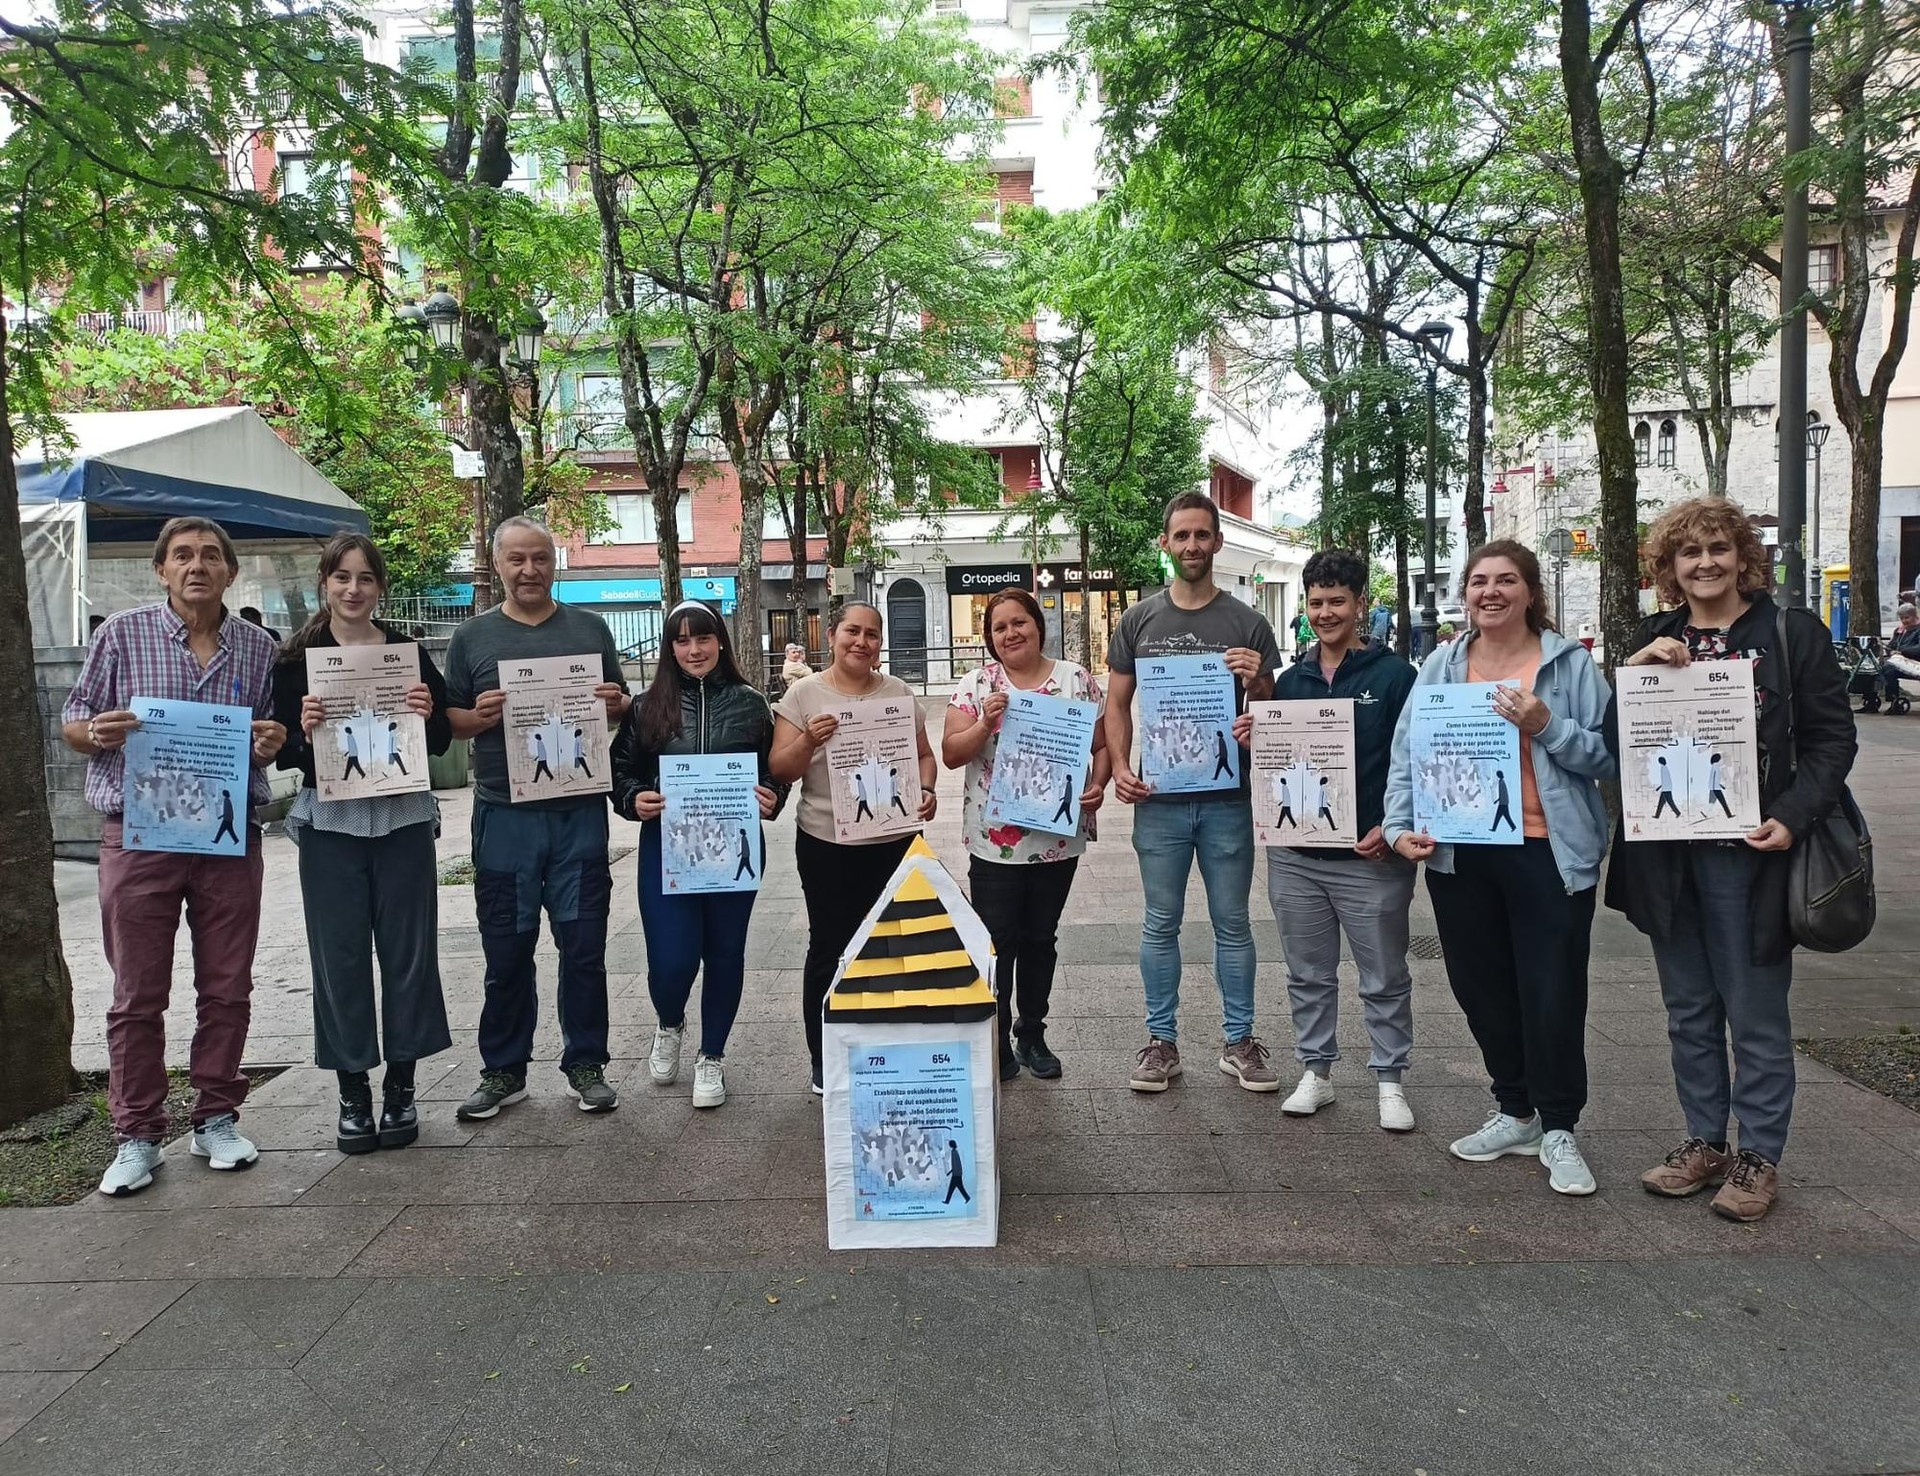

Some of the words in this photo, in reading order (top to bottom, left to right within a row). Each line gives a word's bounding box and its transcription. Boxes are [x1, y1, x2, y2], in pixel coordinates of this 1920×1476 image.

[962, 572, 1021, 586] Ortopedia
[326, 657, 343, 666] 779
[384, 654, 400, 663] 654
[570, 664, 585, 673] 654
[1152, 666, 1165, 674] 779
[1203, 663, 1217, 671] 654
[518, 668, 532, 677] 779
[1708, 672, 1729, 682] 654
[1640, 676, 1659, 685] 779
[1430, 694, 1444, 703] 779
[1020, 699, 1033, 708] 779
[148, 708, 165, 718] 779
[885, 706, 899, 715] 654
[1068, 708, 1082, 717] 654
[1267, 710, 1282, 718] 779
[1320, 709, 1335, 717] 654
[213, 714, 230, 724] 654
[840, 712, 853, 720] 779
[676, 763, 689, 771] 779
[728, 762, 741, 770] 654
[868, 1056, 885, 1066] 779
[932, 1054, 950, 1064] 654
